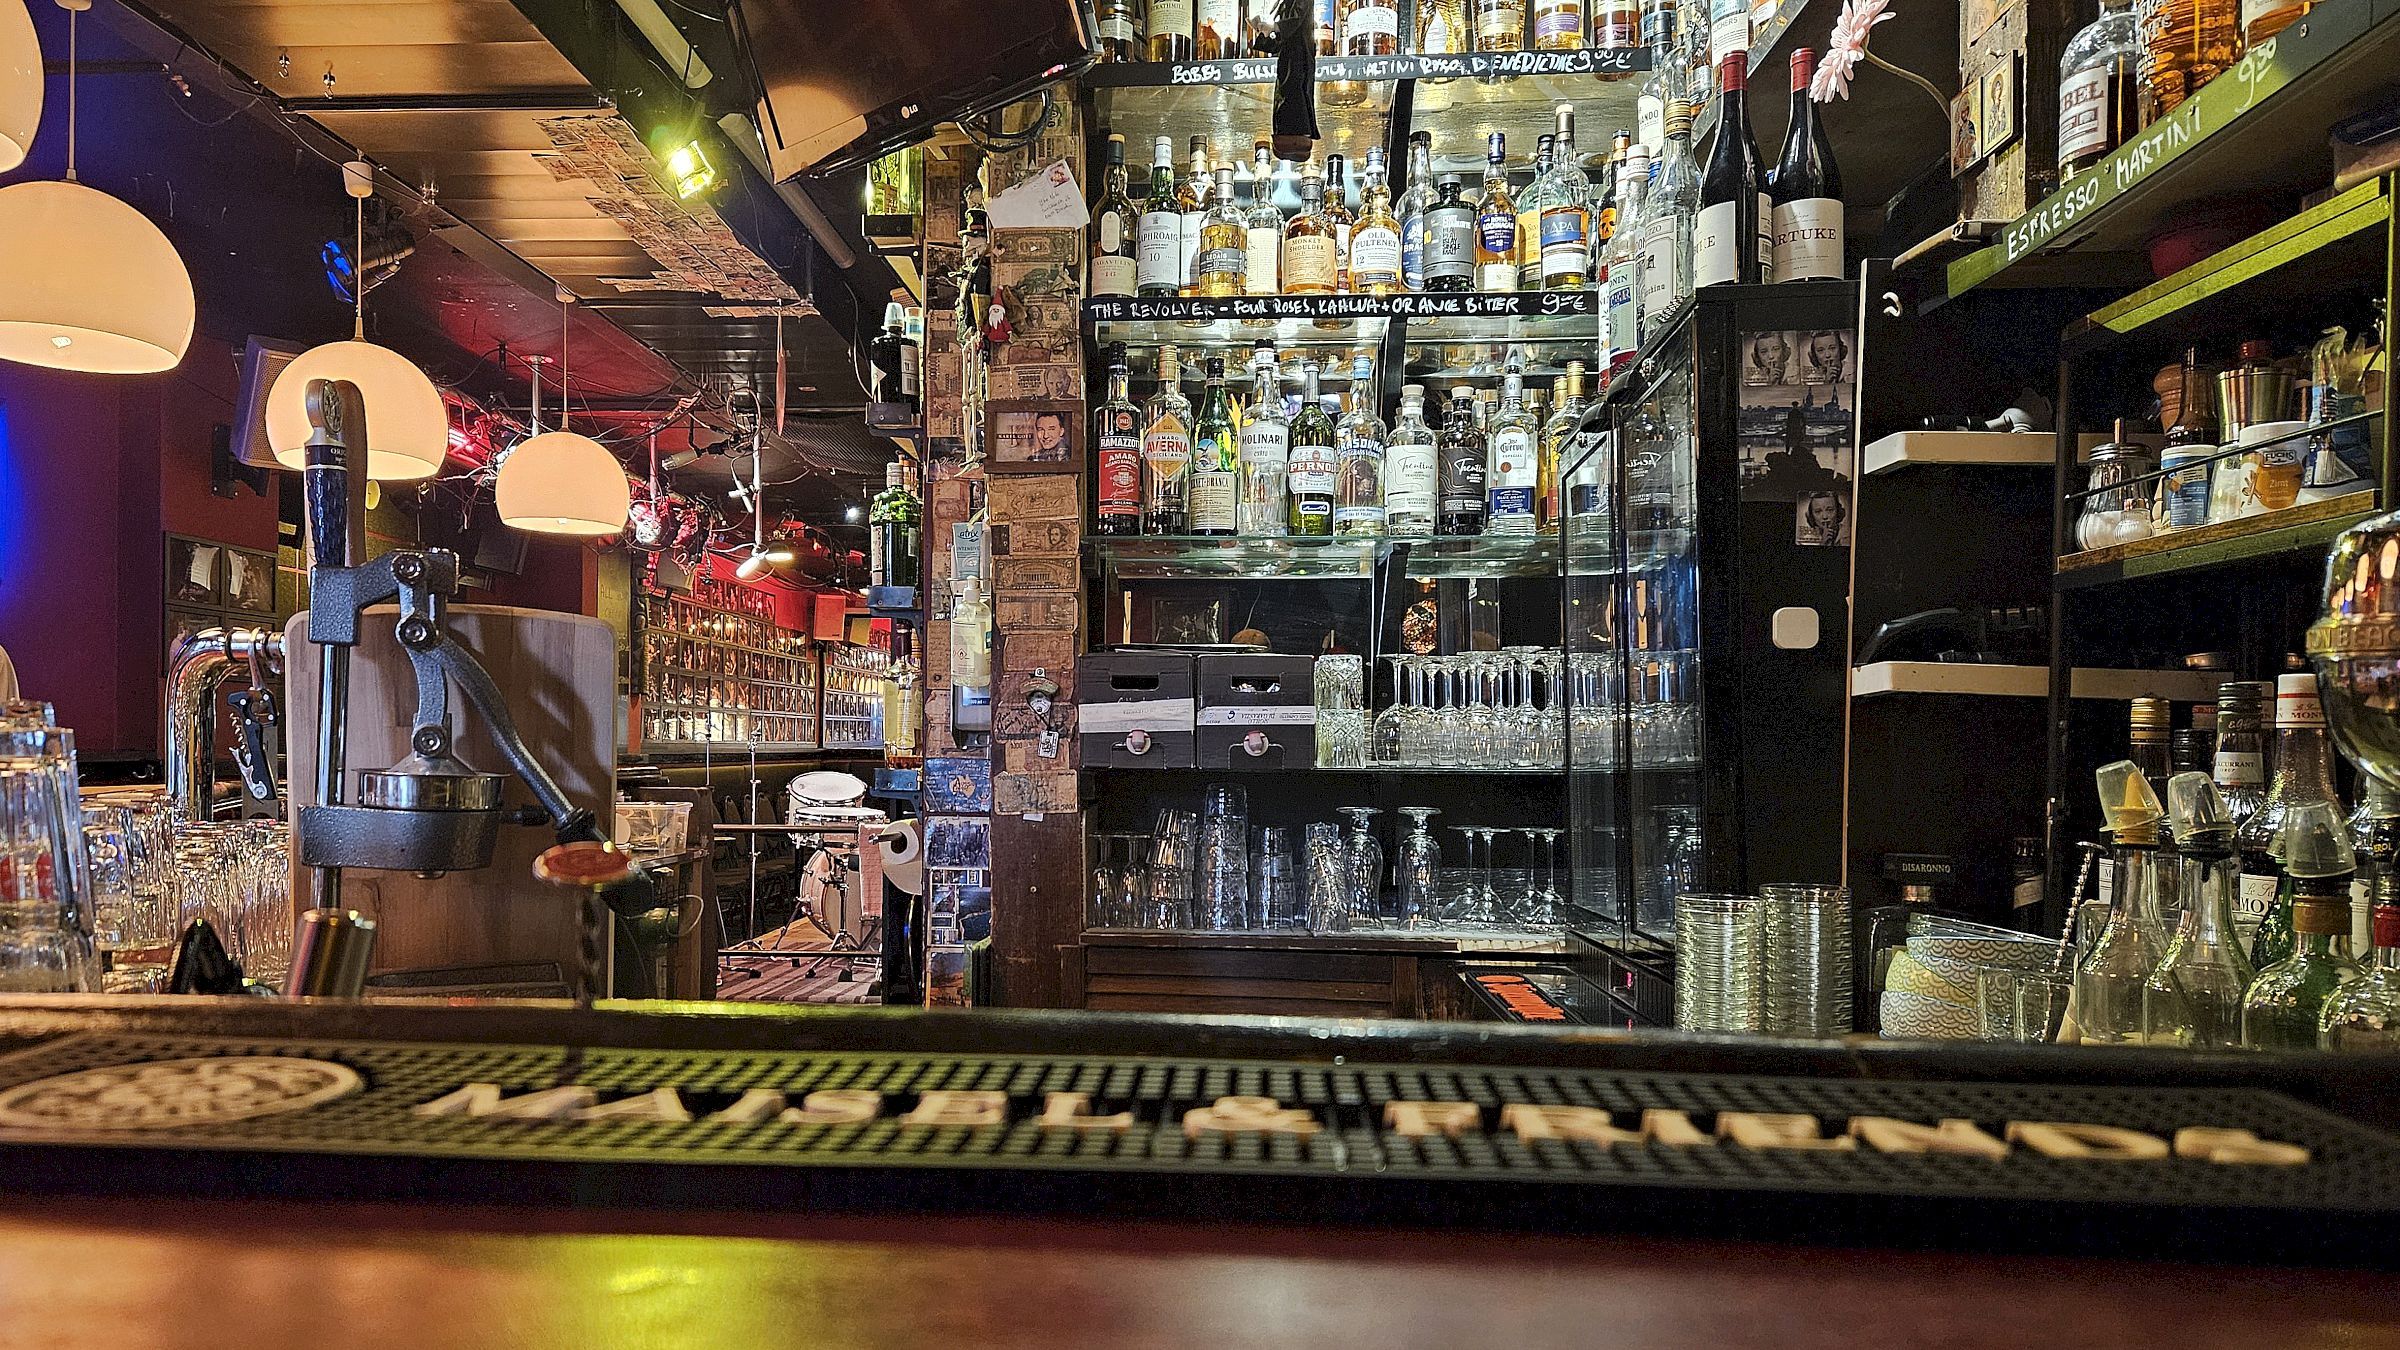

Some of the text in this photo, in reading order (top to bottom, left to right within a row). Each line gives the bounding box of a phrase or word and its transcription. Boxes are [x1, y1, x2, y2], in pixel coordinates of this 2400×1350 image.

[908, 103, 918, 114] LG
[2007, 176, 2099, 262] ESPRESSO
[2115, 96, 2200, 190] MARTINI
[1367, 231, 1386, 239] OLD
[1355, 239, 1398, 249] PULTENEY
[1355, 256, 1365, 266] 12
[1090, 303, 1123, 318] THE
[1233, 300, 1266, 316] FOUR
[1146, 441, 1188, 454] AVERNA
[2264, 451, 2294, 463] FUCHS
[1902, 863, 1951, 874] DISARONNO
